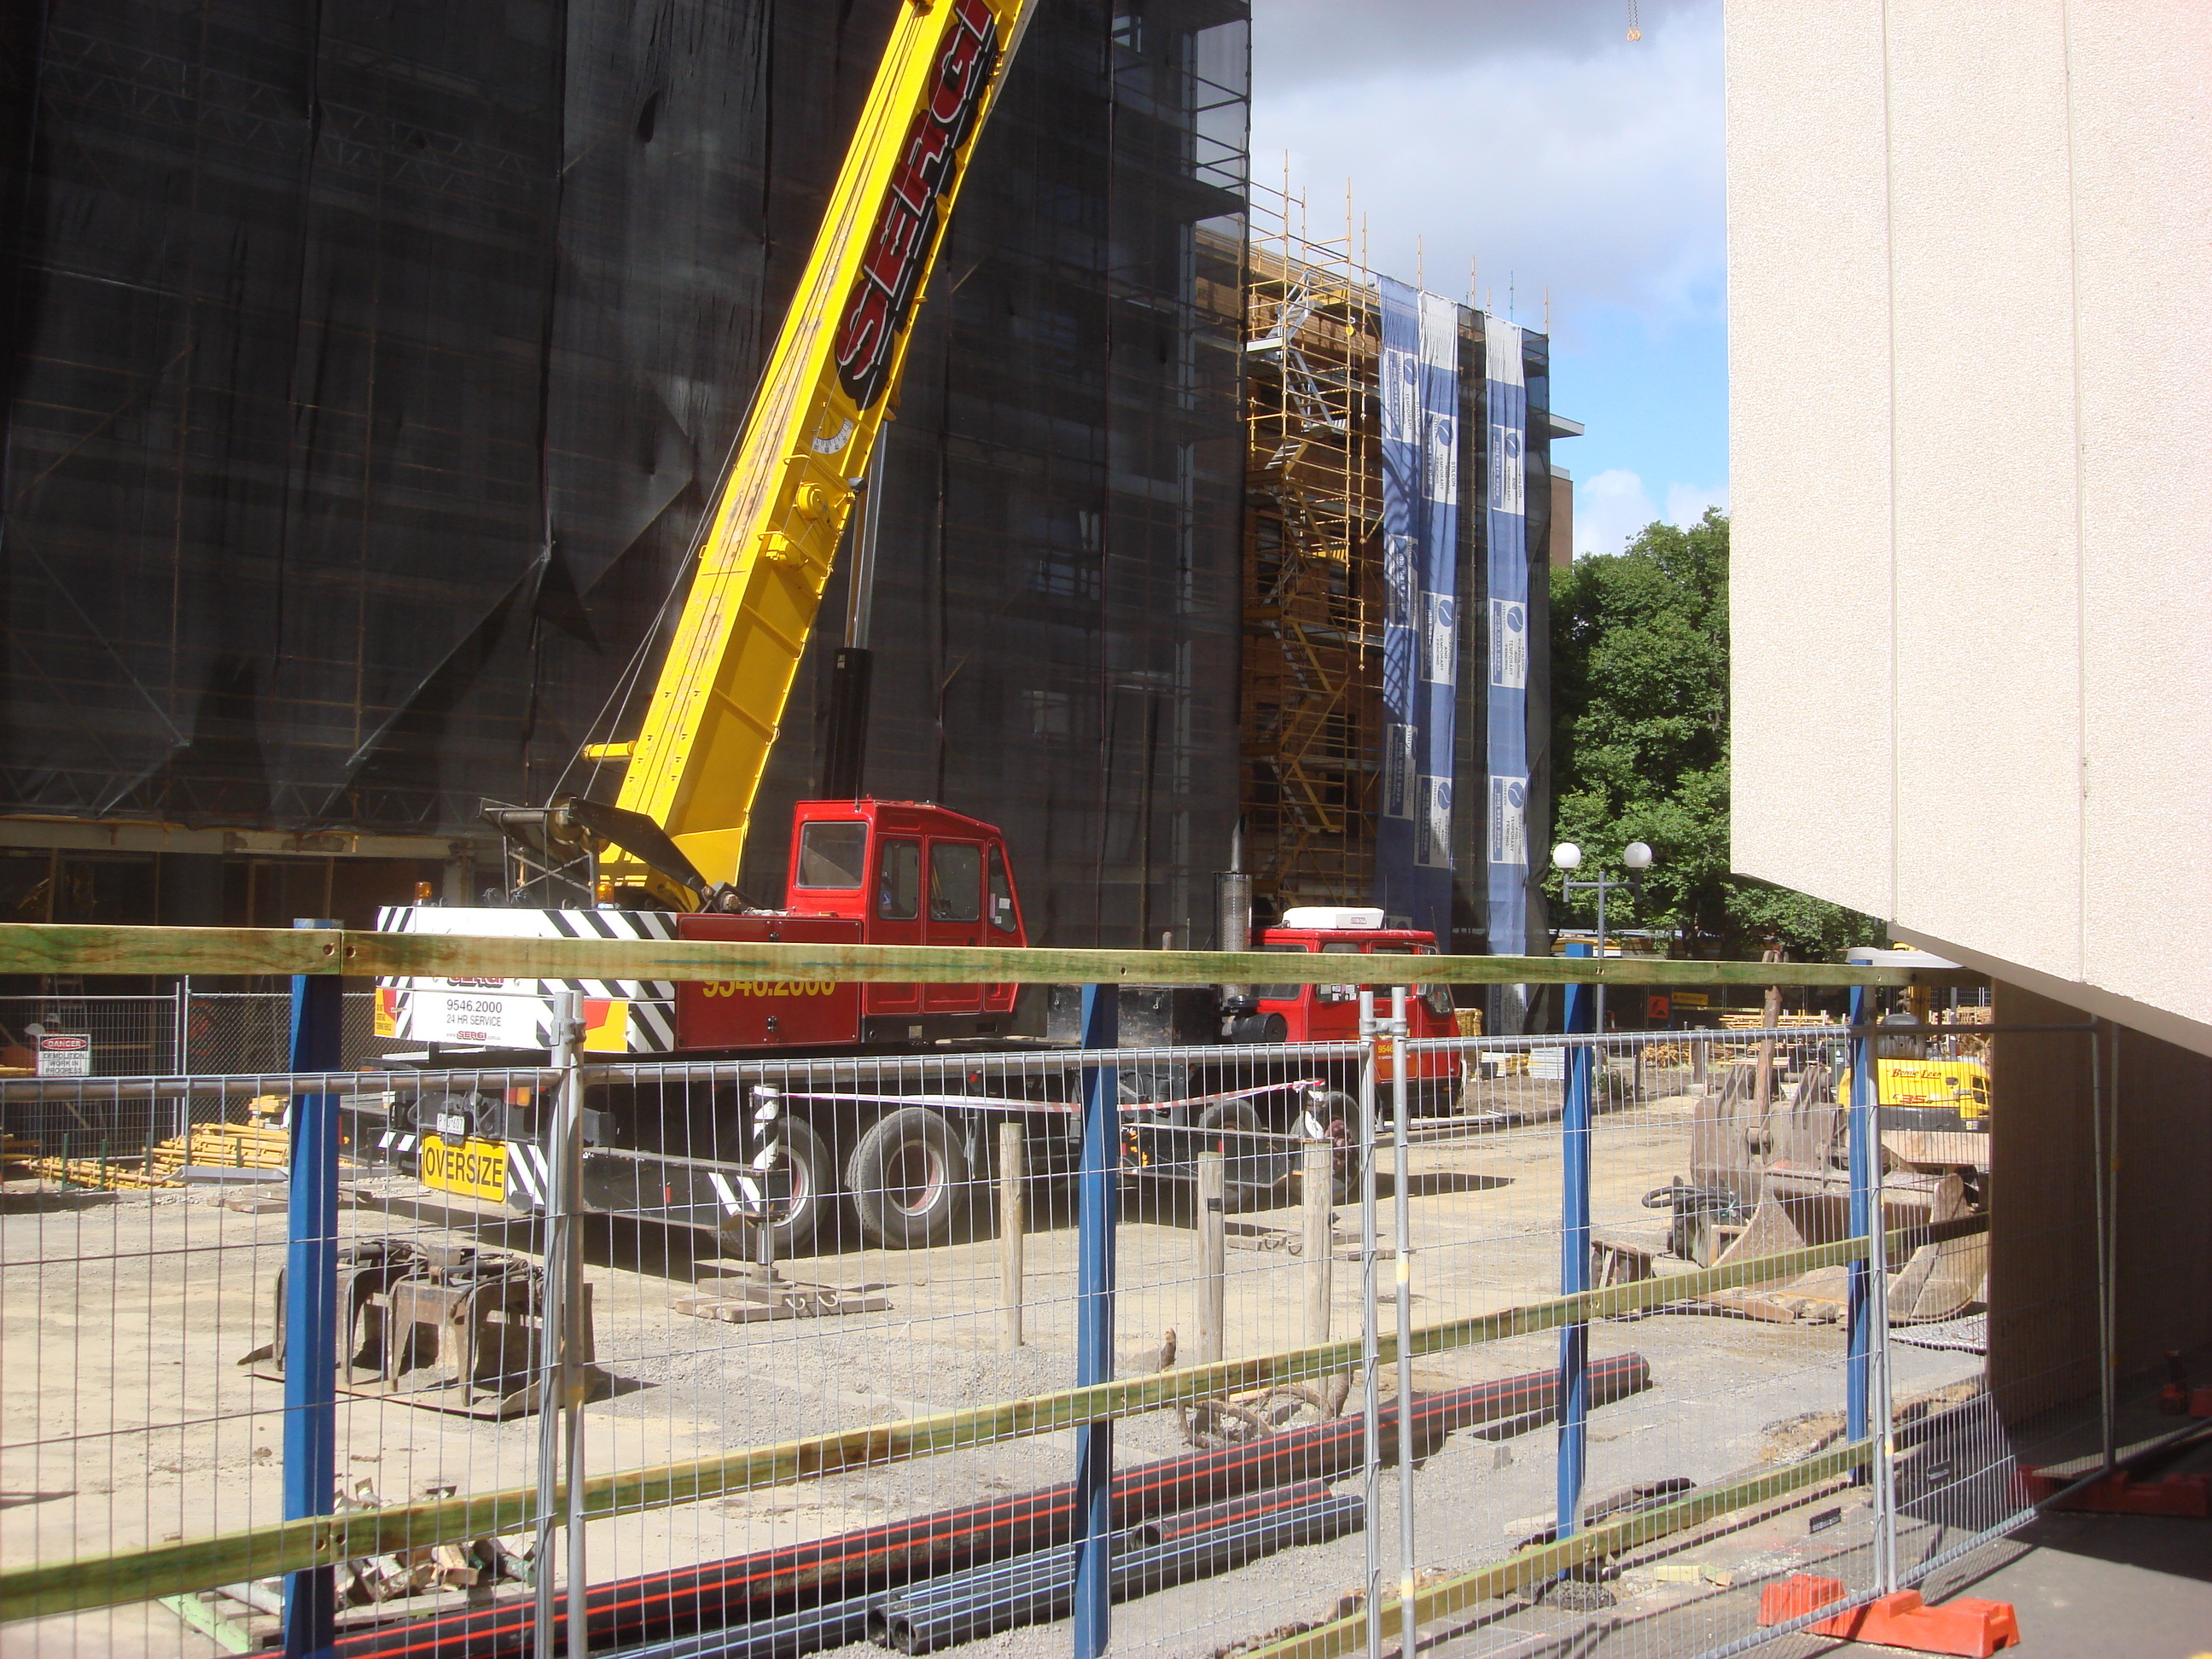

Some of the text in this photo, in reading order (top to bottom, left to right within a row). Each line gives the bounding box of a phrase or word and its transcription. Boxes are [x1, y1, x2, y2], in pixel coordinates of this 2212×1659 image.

[835, 0, 997, 394] SERGI
[446, 999, 503, 1014] 9546.2000
[446, 1014, 502, 1027] 24 HR SERVICE
[426, 1147, 504, 1188] OVERSIZE
